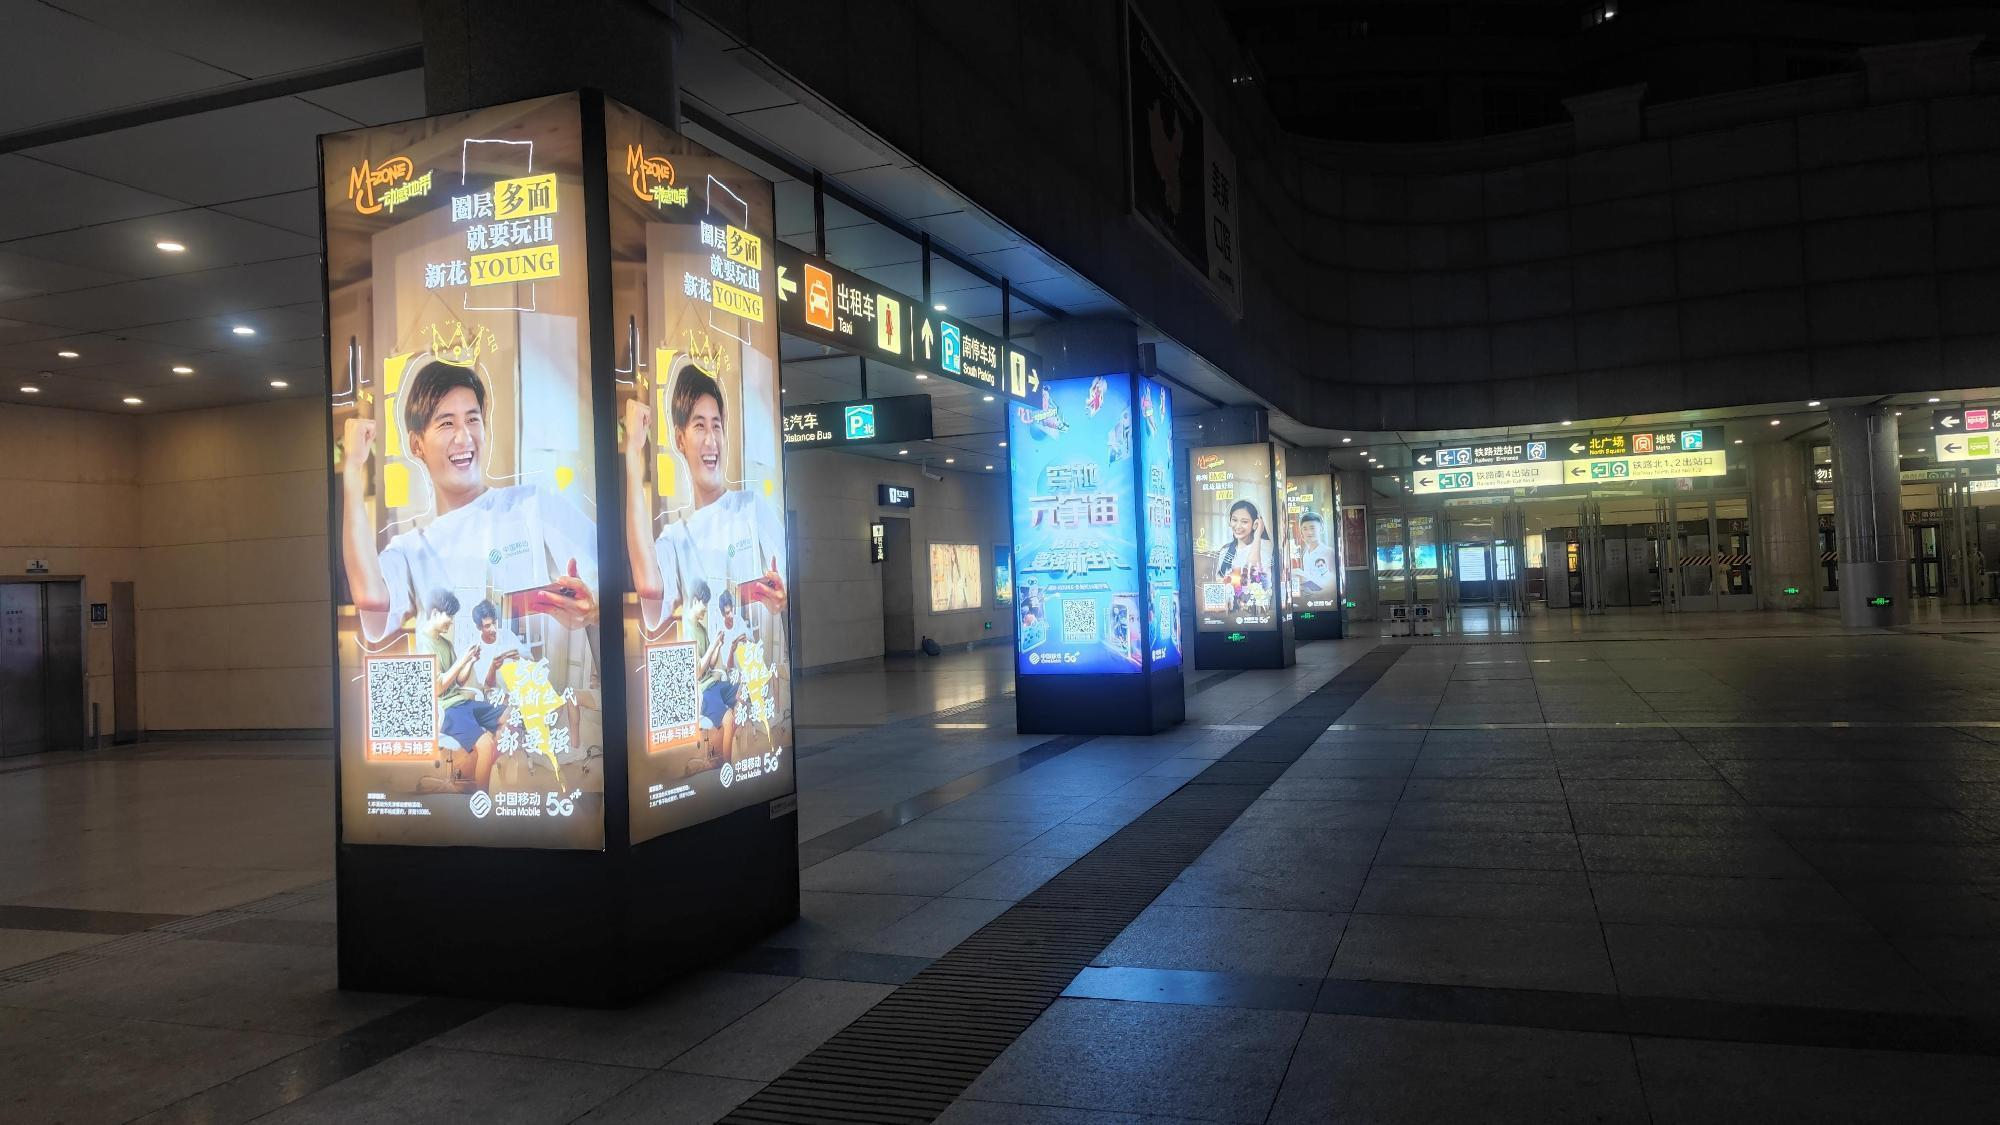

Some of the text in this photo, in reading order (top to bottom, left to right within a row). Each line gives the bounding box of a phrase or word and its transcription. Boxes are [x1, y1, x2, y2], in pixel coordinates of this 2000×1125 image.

[451, 178, 552, 222] 圈层多面
[466, 216, 554, 252] 就要玩出
[710, 254, 760, 292] 就要玩出
[837, 283, 876, 322] 出租车
[838, 318, 853, 335] Taxi
[945, 339, 955, 364] P
[962, 334, 997, 369] 南停车场
[963, 362, 995, 387] South Parking
[850, 415, 864, 435] P
[783, 430, 833, 443] Distance Bus
[1589, 435, 1625, 450] 北广场
[1655, 433, 1677, 444] 地铁
[1474, 445, 1522, 458] 铁路进站口
[1605, 448, 1626, 456] Square
[1476, 468, 1540, 480] 铁路南4出站口
[1029, 493, 1119, 528] 元宇宙
[652, 725, 697, 745] 扫码参与抽奖
[371, 741, 433, 756] 扫码参与抽奖
[735, 756, 762, 772] 中国移动
[735, 770, 762, 782] China Mobile
[495, 791, 541, 806] 中国移动
[495, 806, 541, 817] China Mobile
